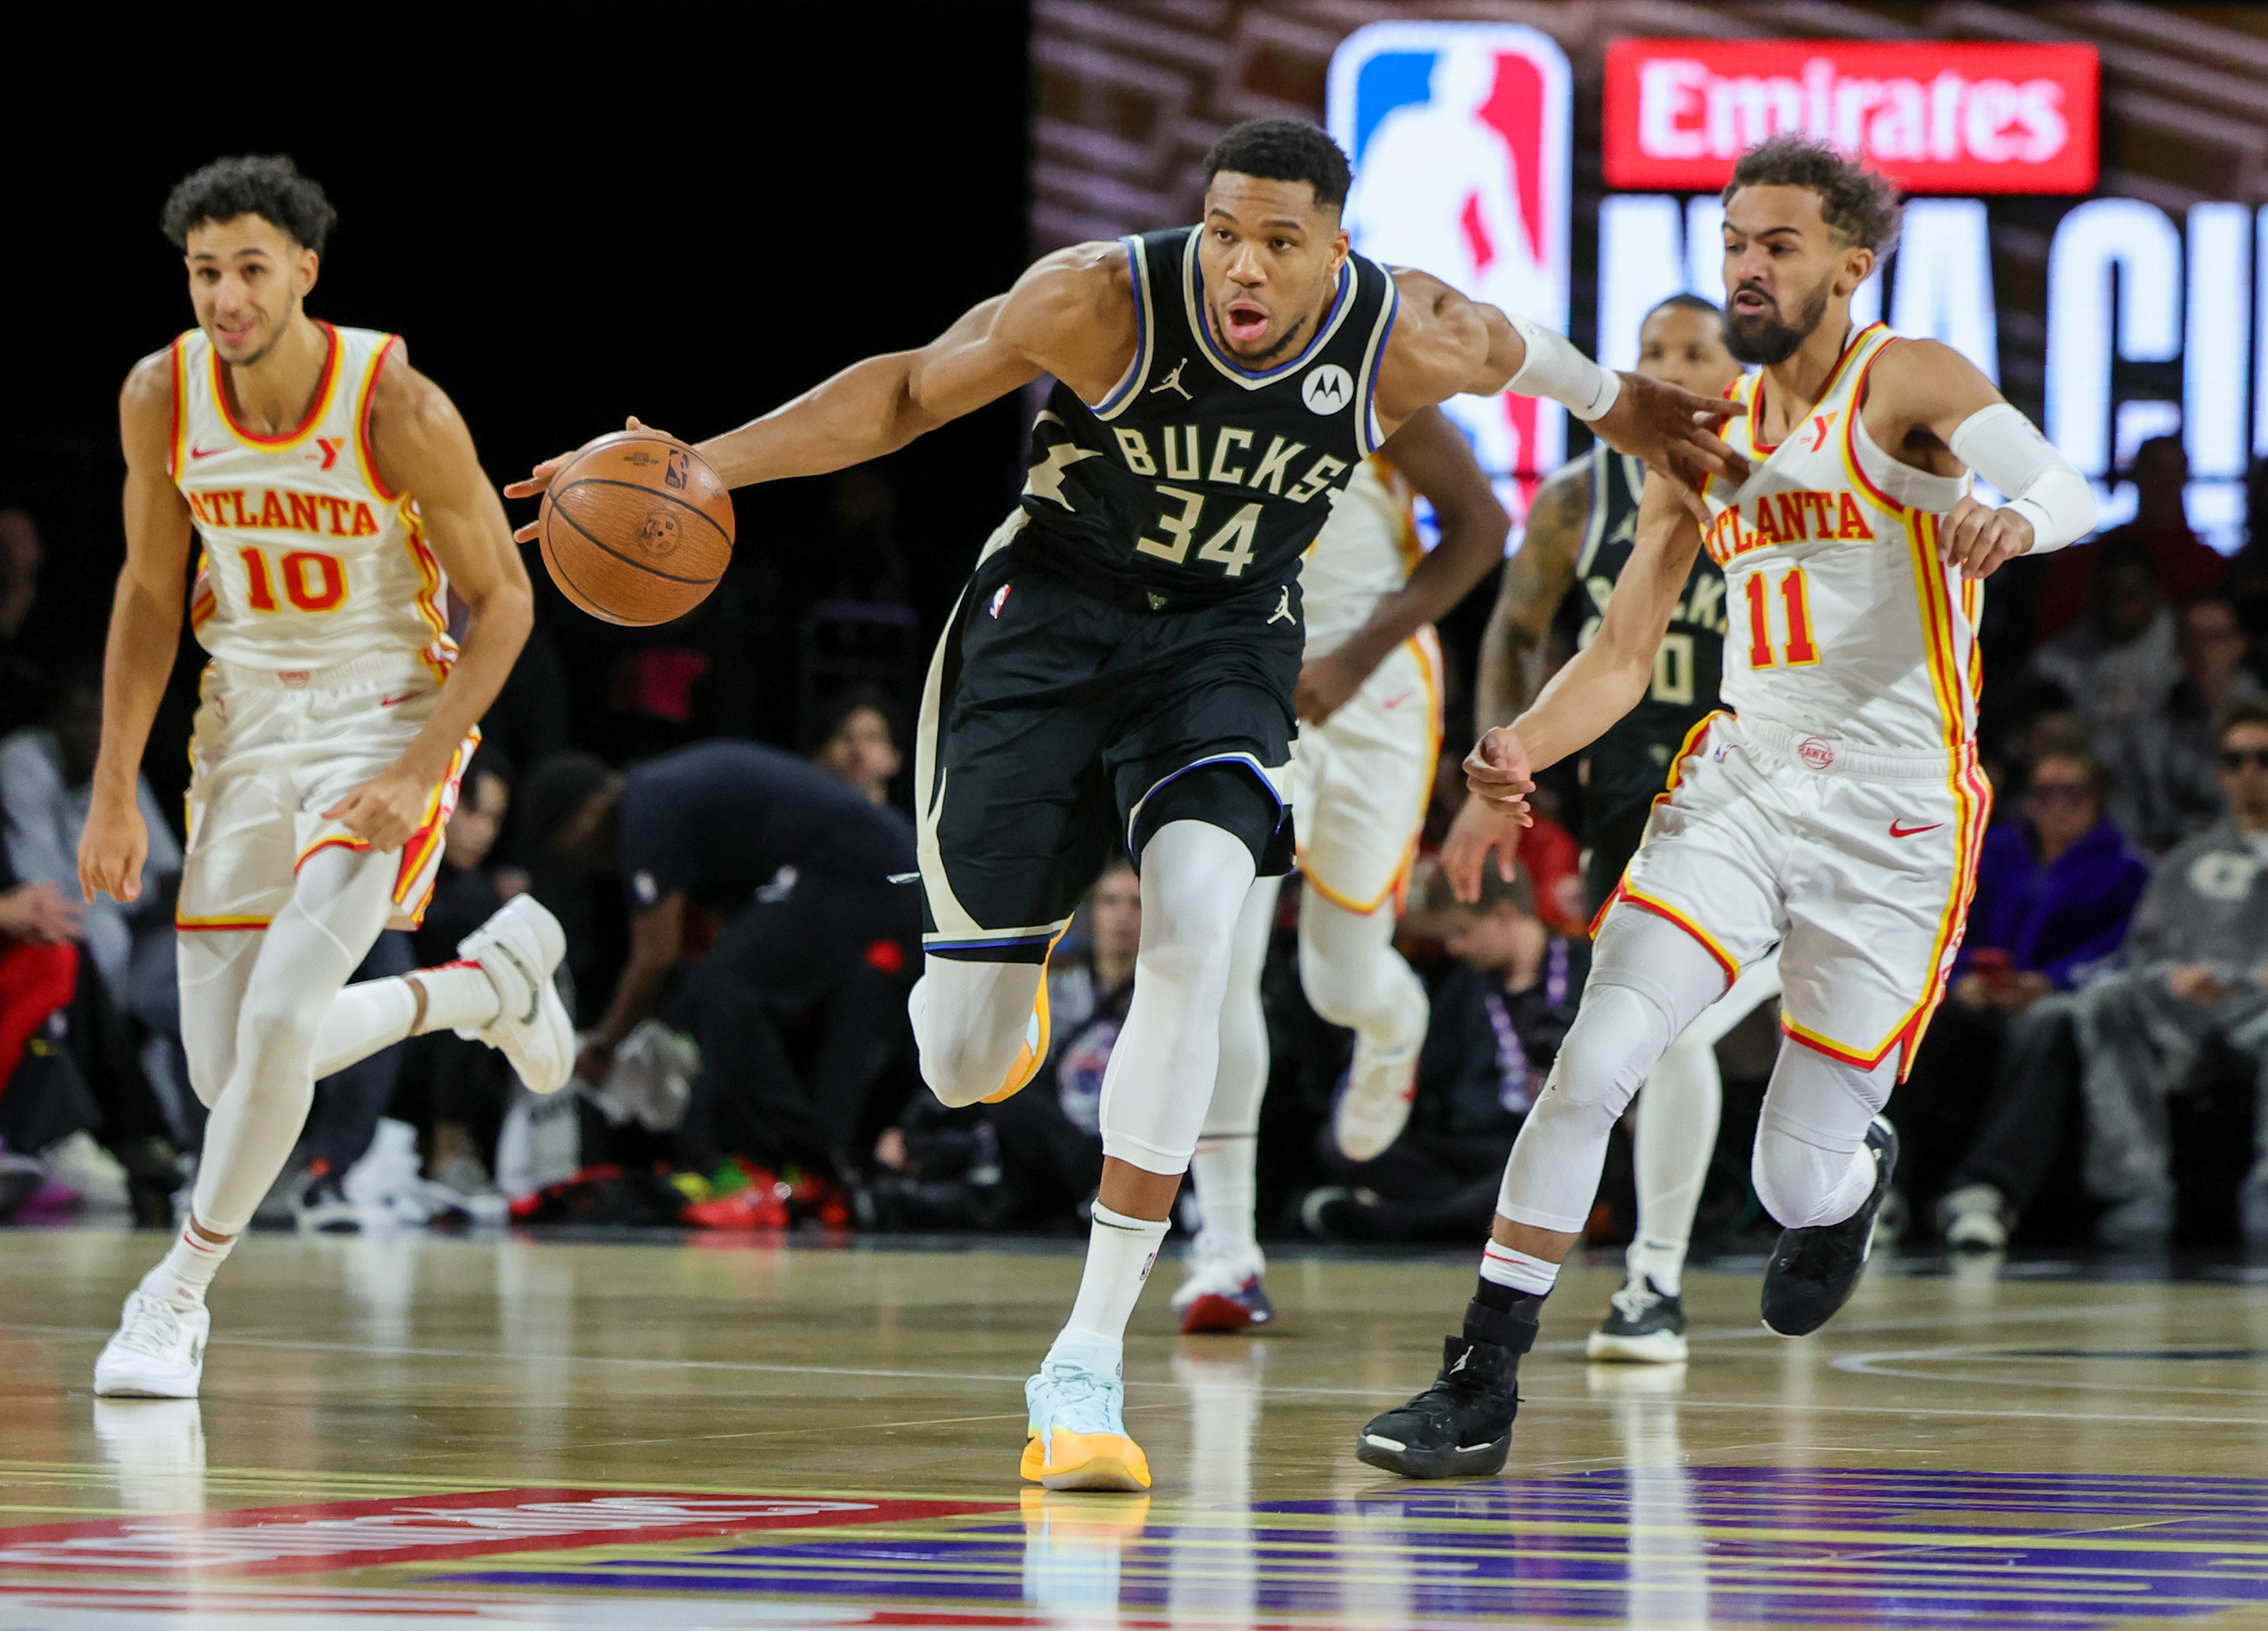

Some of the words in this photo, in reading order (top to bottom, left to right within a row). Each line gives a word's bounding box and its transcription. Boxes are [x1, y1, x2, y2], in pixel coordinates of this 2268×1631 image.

[1638, 56, 2070, 164] Emirates
[1112, 424, 1349, 503] BUCKS
[1134, 484, 1264, 578] 34
[239, 546, 349, 613] 10
[1744, 566, 1821, 670] 11
